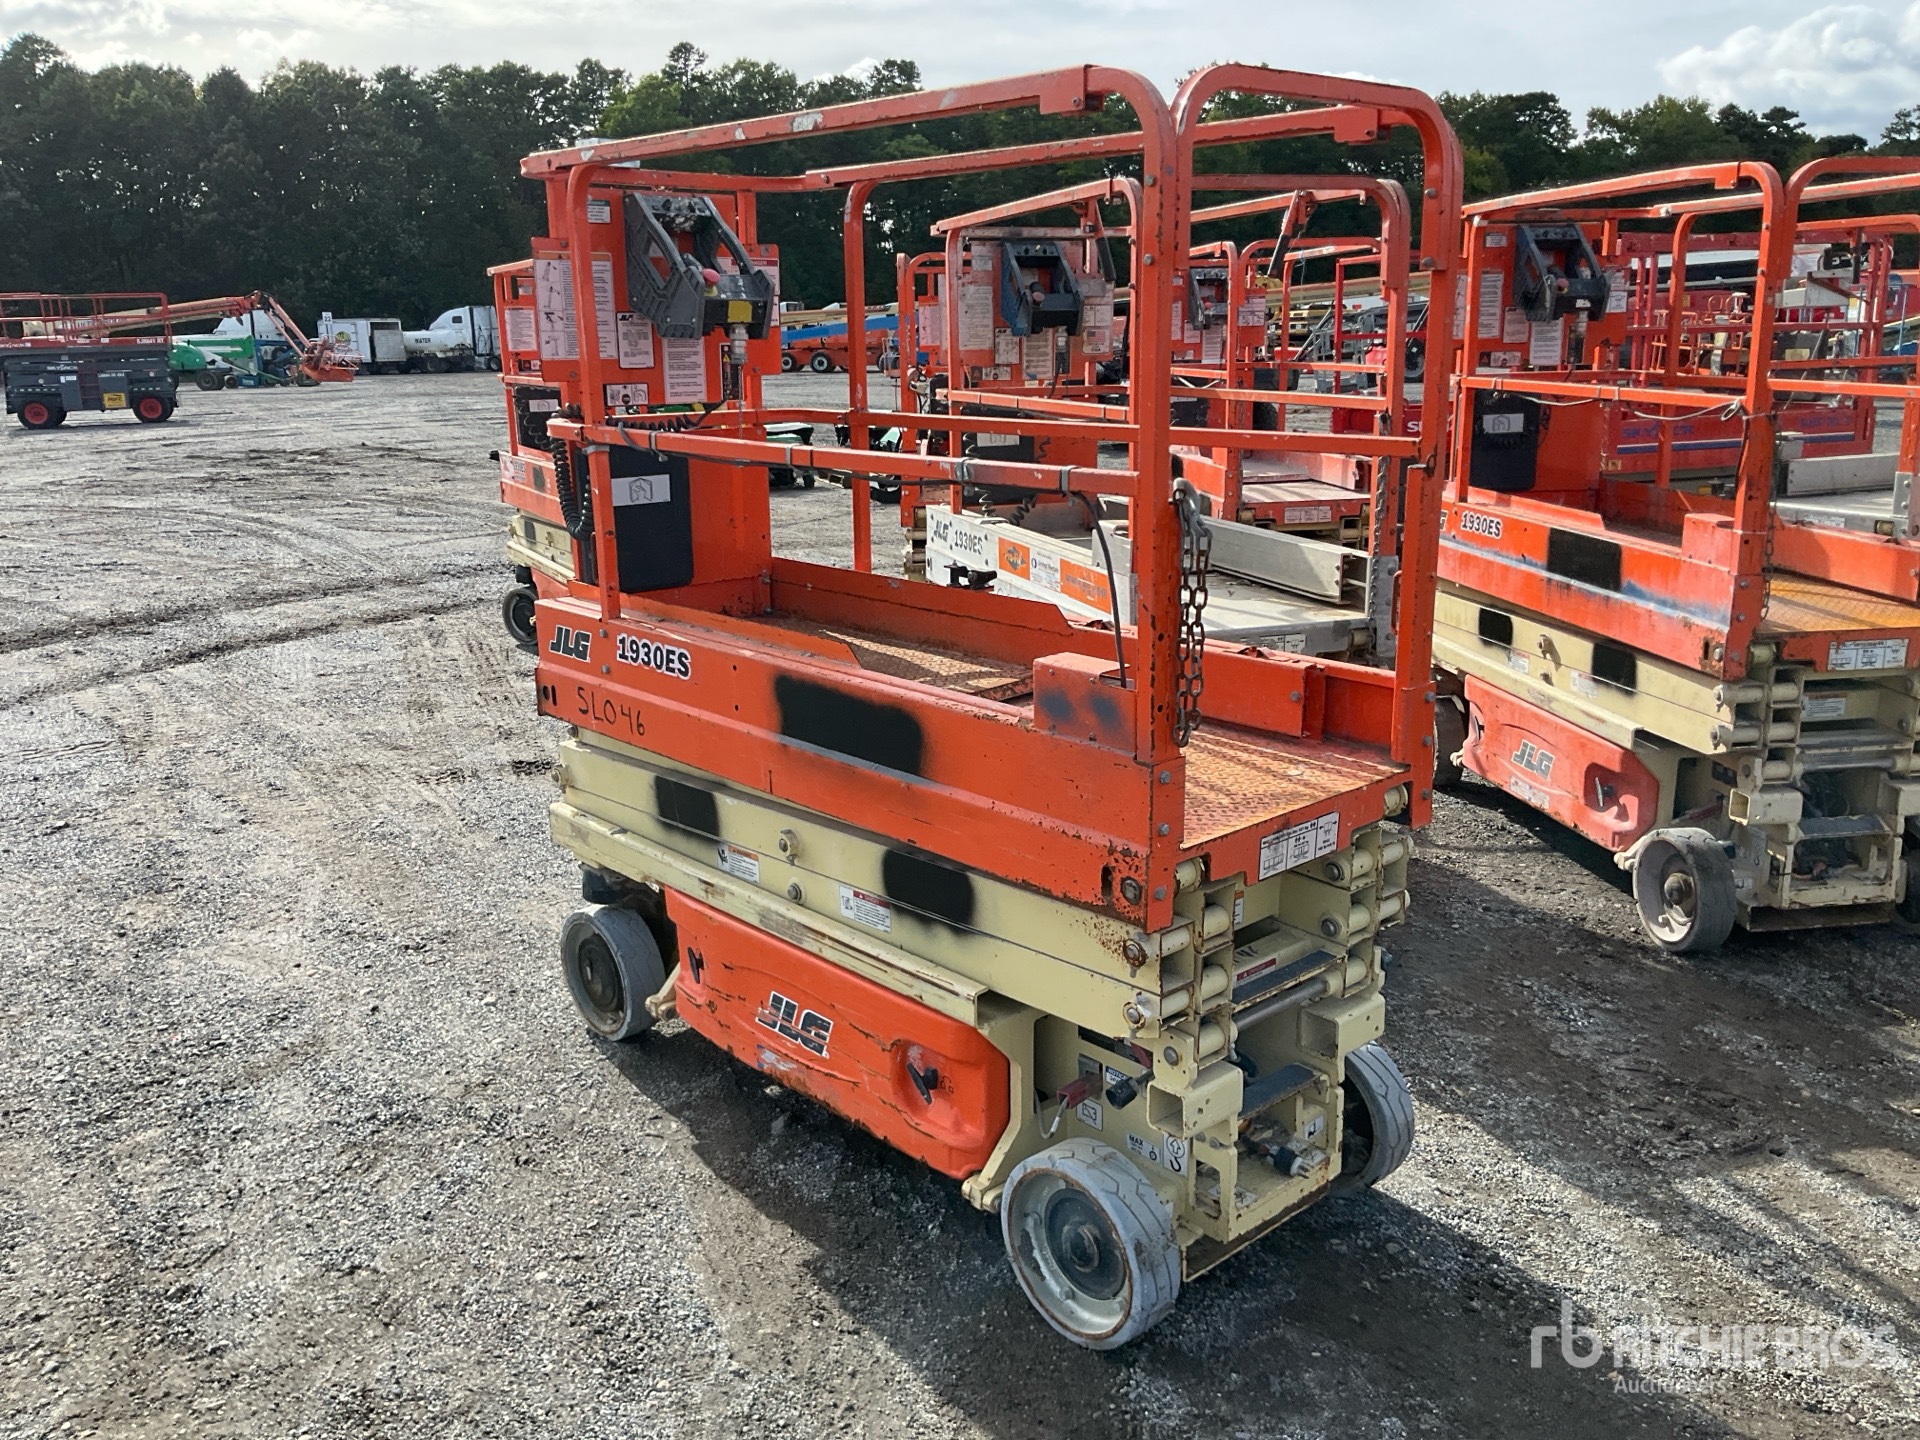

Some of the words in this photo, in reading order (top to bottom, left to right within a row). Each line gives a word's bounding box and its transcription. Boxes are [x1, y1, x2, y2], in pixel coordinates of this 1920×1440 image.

[1461, 511, 1502, 538] 1930ES
[954, 529, 983, 556] 1930ES
[549, 625, 591, 662] JLG
[617, 633, 690, 679] 1930ES
[1511, 740, 1555, 781] JLG
[755, 991, 833, 1058] JLG
[1129, 1135, 1143, 1145] MAX
